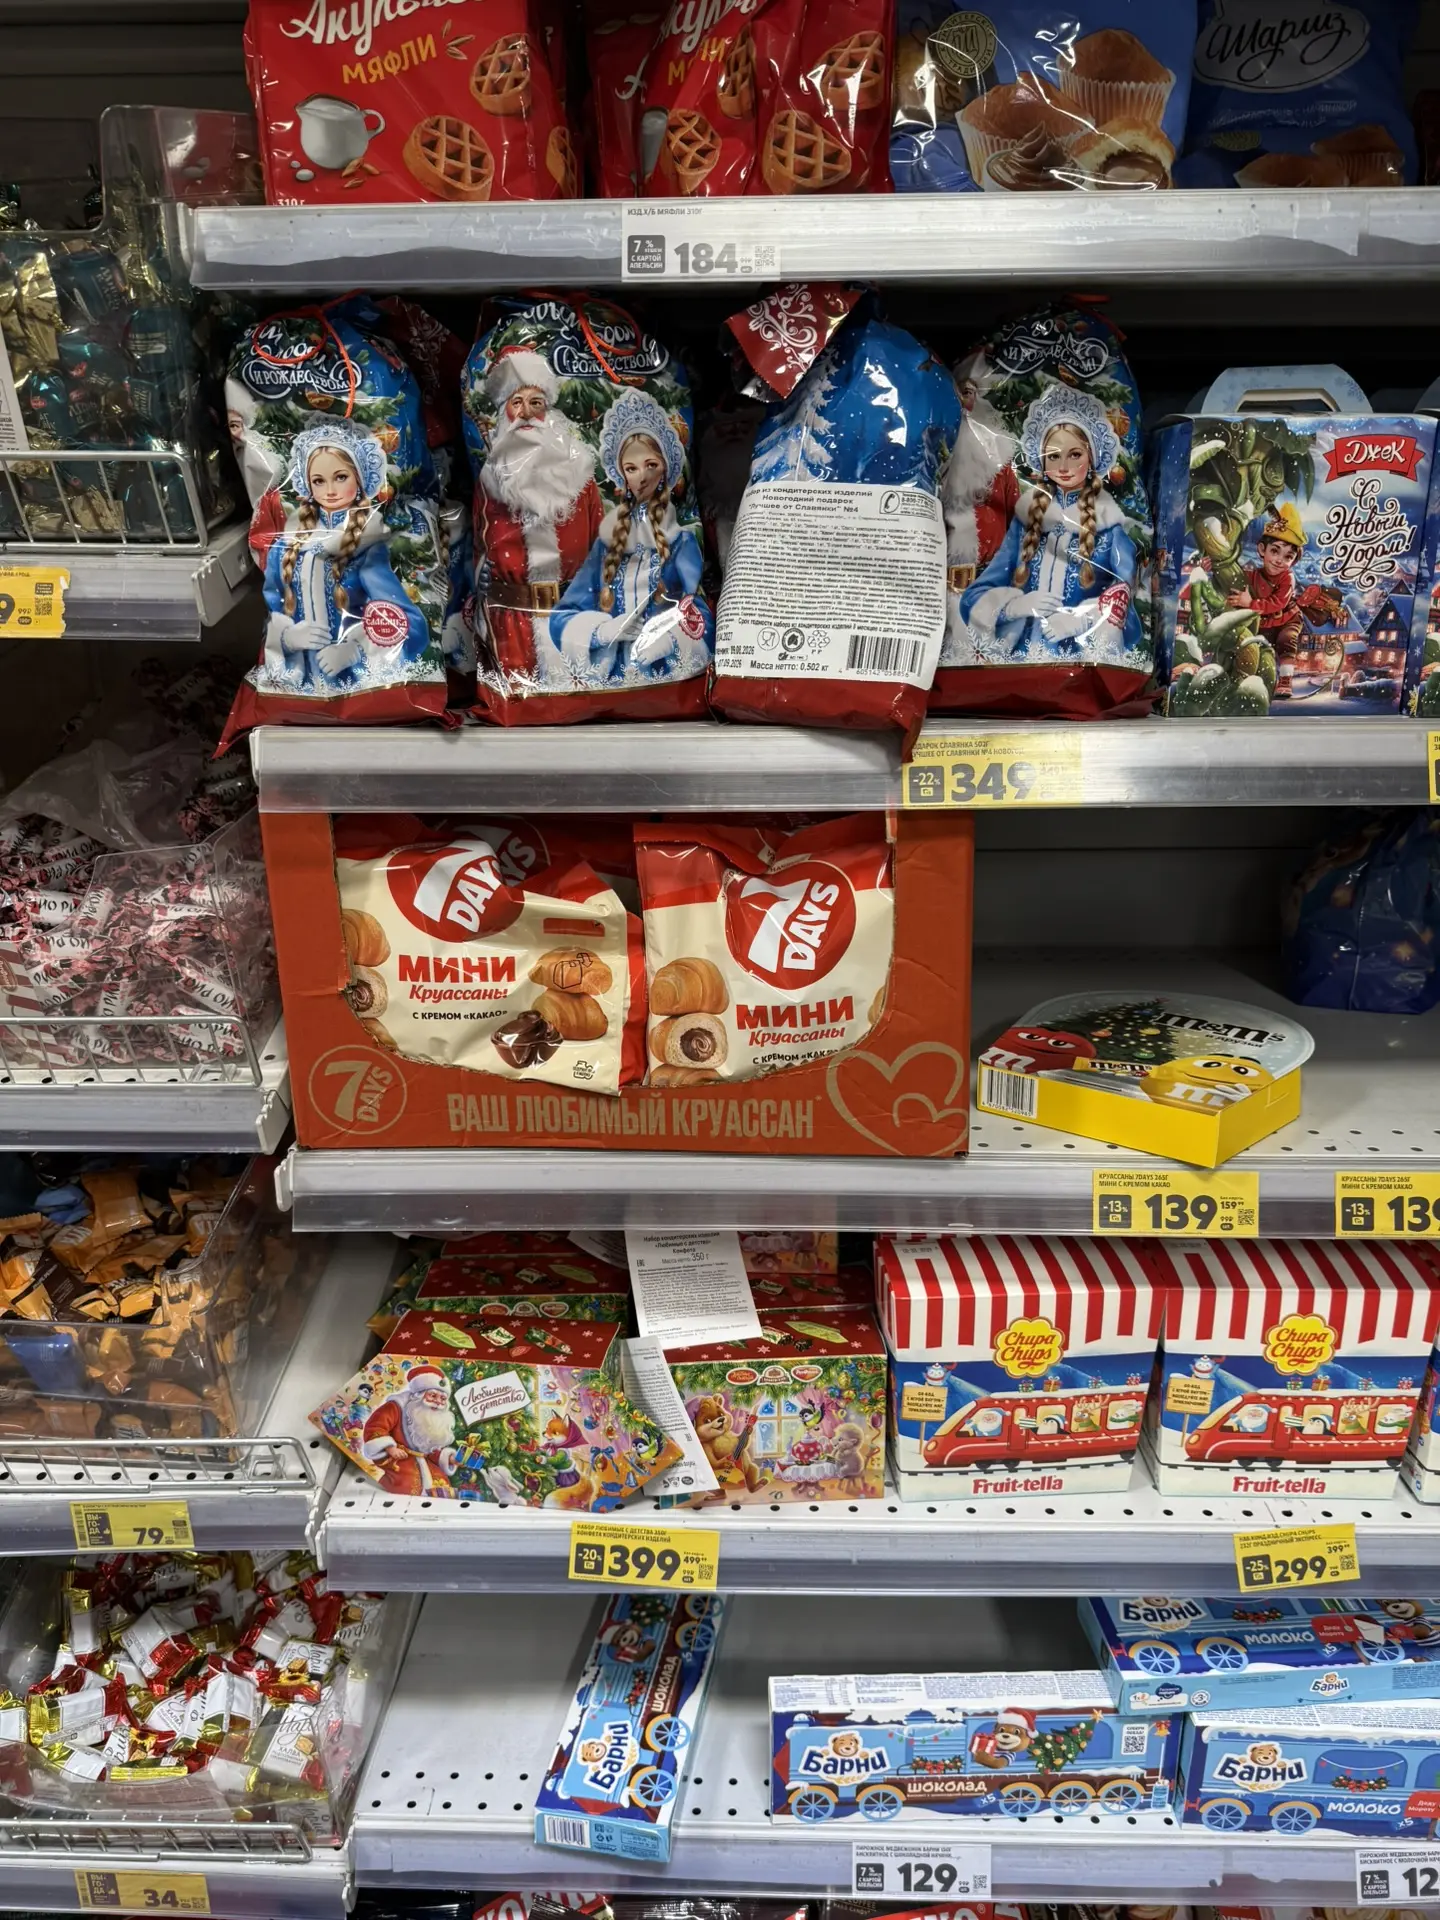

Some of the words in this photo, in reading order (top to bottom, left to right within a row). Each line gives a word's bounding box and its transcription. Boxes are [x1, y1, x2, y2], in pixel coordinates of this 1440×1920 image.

[342, 34, 437, 84] МЯФЛИ
[633, 240, 642, 253] 7
[645, 240, 654, 248] %
[636, 253, 662, 262] КАРТОЙ
[674, 242, 738, 274] 184
[1344, 439, 1406, 464] Джек
[762, 495, 814, 503] Новогодний
[816, 497, 854, 505] подарок
[772, 487, 832, 496] кондитерских
[1351, 478, 1381, 510] С
[843, 506, 859, 514] №4
[750, 661, 774, 670] Масса
[775, 663, 799, 671] нетто:
[799, 662, 820, 672] 0,502
[936, 750, 944, 758] ОТ
[913, 773, 941, 786] -22%
[951, 762, 1037, 802] 349
[741, 878, 810, 973] 7
[783, 881, 839, 970] DAYS
[398, 955, 517, 983] МИНИ
[409, 984, 508, 1004] Круассаны
[412, 1012, 419, 1020] С
[421, 1012, 461, 1020] КРЕМОМ
[463, 1010, 508, 1021] «КАКАО»
[736, 996, 855, 1030] МИНИ
[748, 1026, 846, 1048] Круассаны
[752, 1056, 760, 1065] С
[761, 1053, 799, 1065] КРЕМОМ
[324, 1060, 373, 1122] 7
[357, 1066, 393, 1122] DAYS
[447, 1093, 509, 1132] ВАШ
[515, 1093, 668, 1137] ЛЮБИМЫЙ
[672, 1096, 814, 1138] КРУАССАН
[1103, 1201, 1128, 1213] -13%
[1144, 1194, 1218, 1230] 139
[1220, 1201, 1237, 1210] 159
[661, 1233, 697, 1241] кондитерских
[691, 1252, 705, 1262] 350
[1004, 1331, 1056, 1347] Chupa
[1276, 1327, 1328, 1344] Chupa
[1001, 1346, 1053, 1369] Chups
[1271, 1343, 1324, 1366] Chups
[472, 1406, 480, 1415] с
[480, 1391, 526, 1421] детства
[972, 1476, 1063, 1494] Fruit-tella
[1232, 1476, 1326, 1494] Fruit-tella
[132, 1527, 164, 1545] 79
[595, 1525, 624, 1533] ЛЮБИМЫЕ
[630, 1528, 653, 1536] ДЕТСТВА
[1327, 1545, 1344, 1554] 399
[608, 1545, 681, 1581] 399
[683, 1556, 700, 1564] 499
[1274, 1555, 1327, 1583] 299
[1123, 1600, 1202, 1622] Барни
[1244, 1630, 1316, 1646] МОЛОКО
[650, 1656, 679, 1713] ШОКОЛАД
[1311, 1679, 1349, 1693] Барни
[589, 1723, 629, 1790] Барни
[803, 1749, 888, 1775] Барни
[1216, 1760, 1304, 1783] Барни
[907, 1780, 988, 1794] ШОКОЛАД
[1327, 1802, 1401, 1815] МОЛОКО
[1398, 1856, 1428, 1864] МОЛОЧНОЙ
[860, 1867, 867, 1876] 7
[897, 1862, 958, 1892] 129
[1365, 1875, 1372, 1884] 7
[143, 1889, 179, 1907] 34
